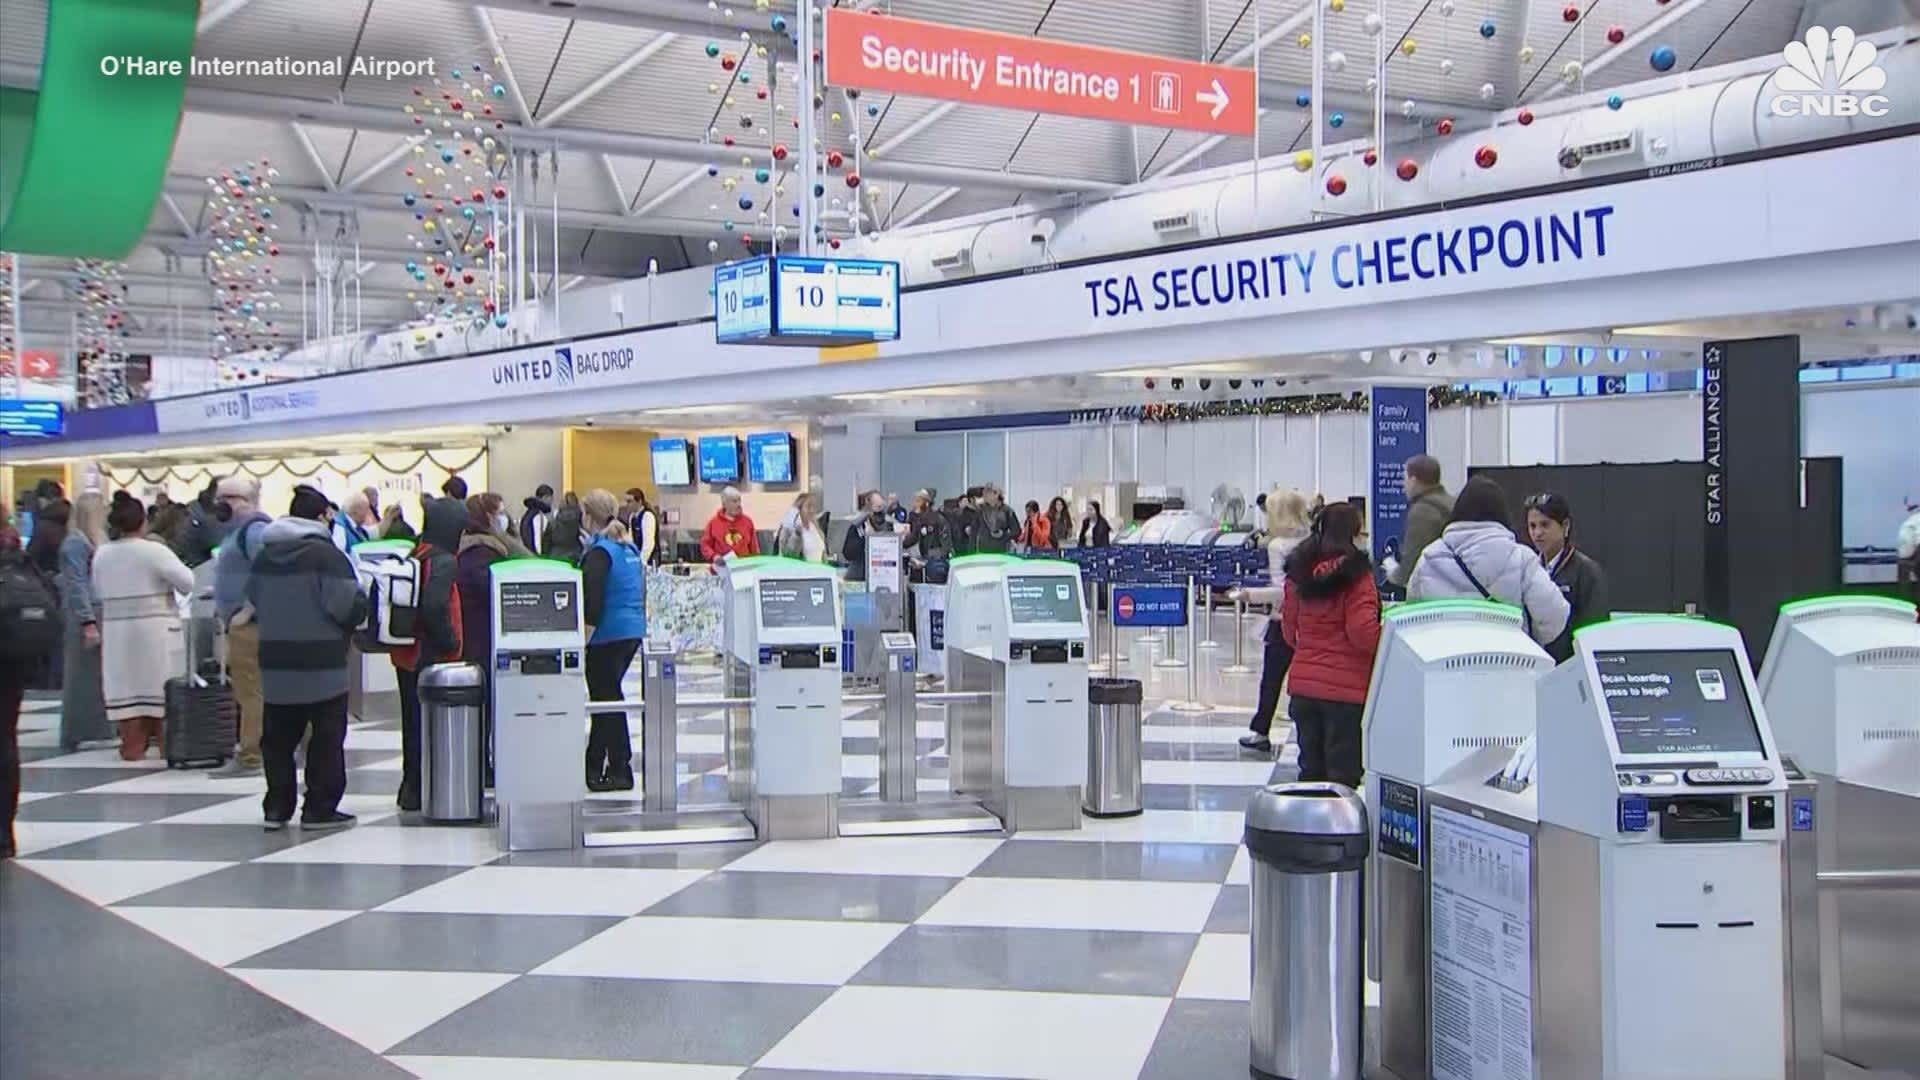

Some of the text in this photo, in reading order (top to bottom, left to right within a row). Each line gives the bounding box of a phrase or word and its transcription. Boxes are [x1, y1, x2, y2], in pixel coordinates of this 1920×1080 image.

[862, 35, 1141, 104] Security Entrance 1
[1085, 206, 1615, 318] TSA SECURITY CHECKPOINT
[724, 290, 737, 314] 10
[796, 285, 824, 308] 10
[493, 347, 635, 384] UNITED BAG DROP
[1378, 403, 1409, 419] Family
[1378, 419, 1421, 434] screening
[1378, 434, 1397, 447] lane
[1706, 368, 1721, 524] STAR ALLIANCE
[1135, 602, 1180, 611] DO NOT ENTER
[1601, 673, 1671, 684] Scan boarding
[1605, 686, 1670, 698] pass to begin
